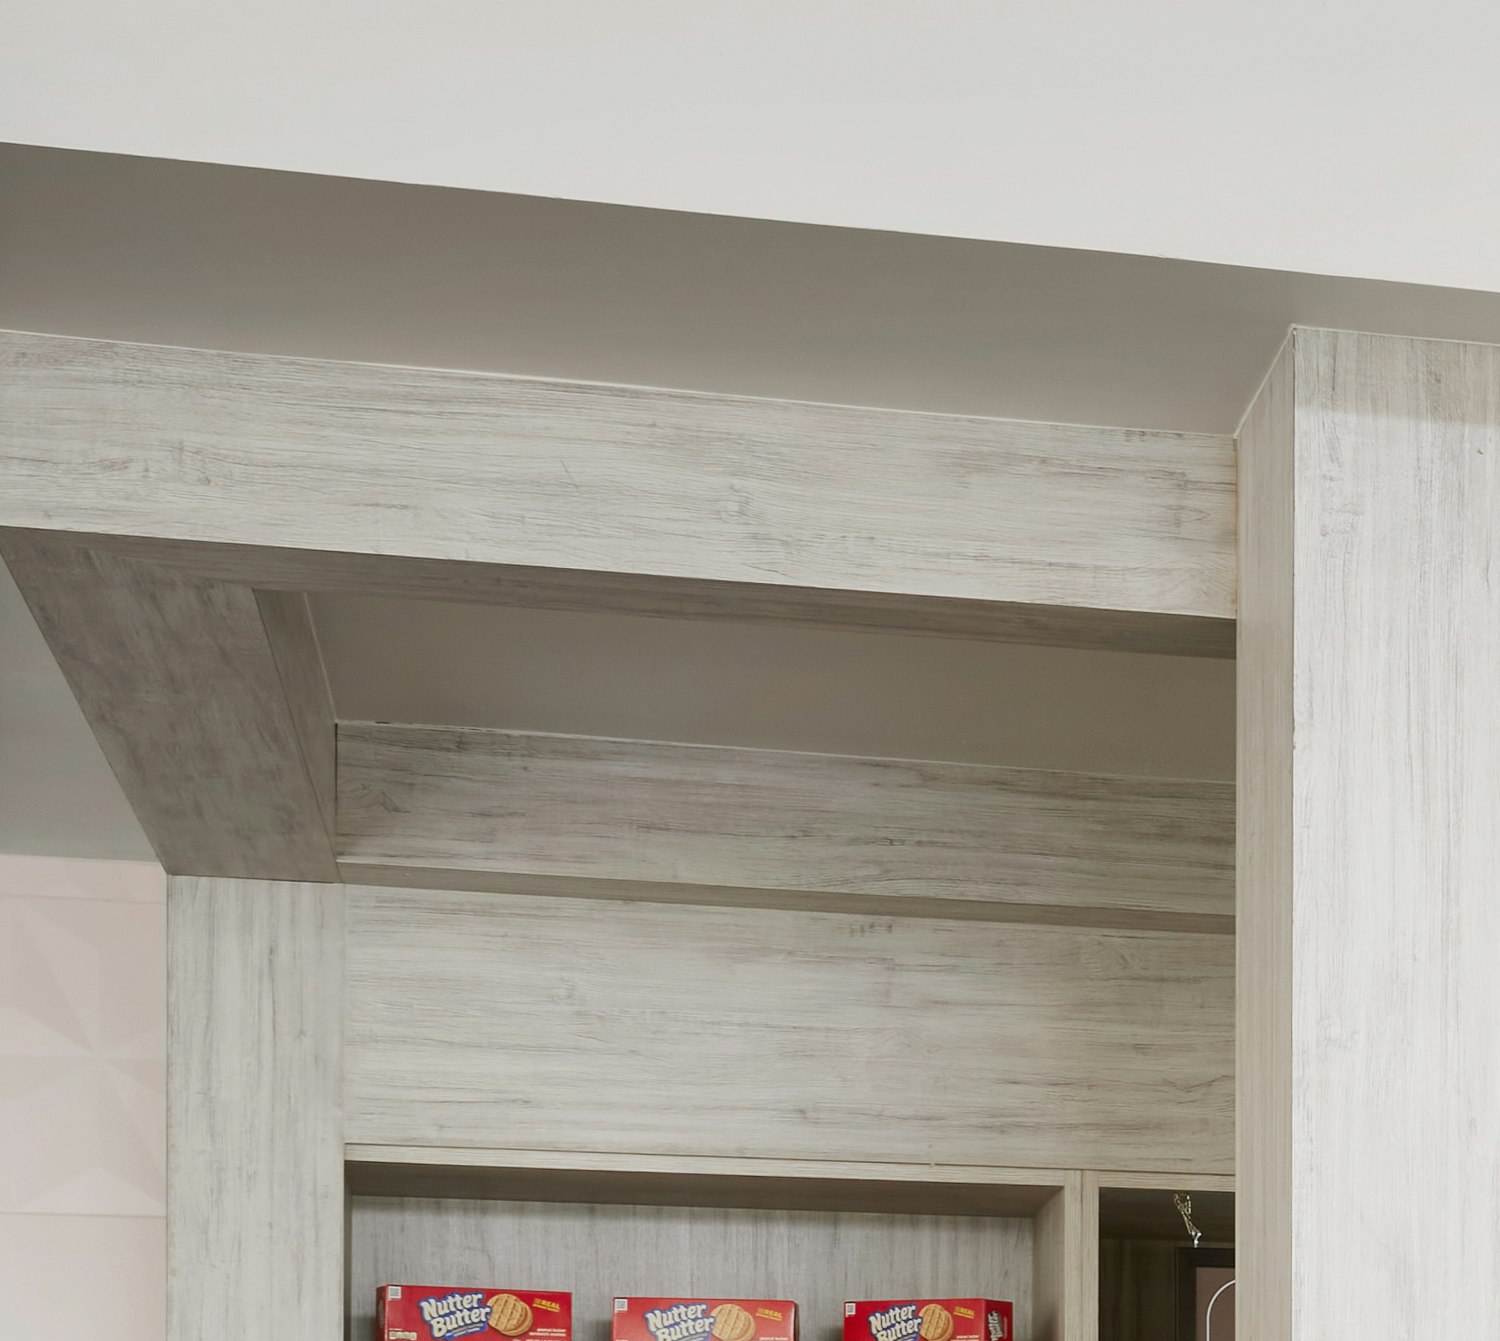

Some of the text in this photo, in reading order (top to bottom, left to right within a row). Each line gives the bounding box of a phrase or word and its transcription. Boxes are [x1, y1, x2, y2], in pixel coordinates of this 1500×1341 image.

[421, 1293, 483, 1320] Nutter
[645, 1304, 707, 1332] Nutter
[869, 1305, 916, 1333] Nutter
[431, 1306, 491, 1338] Butter
